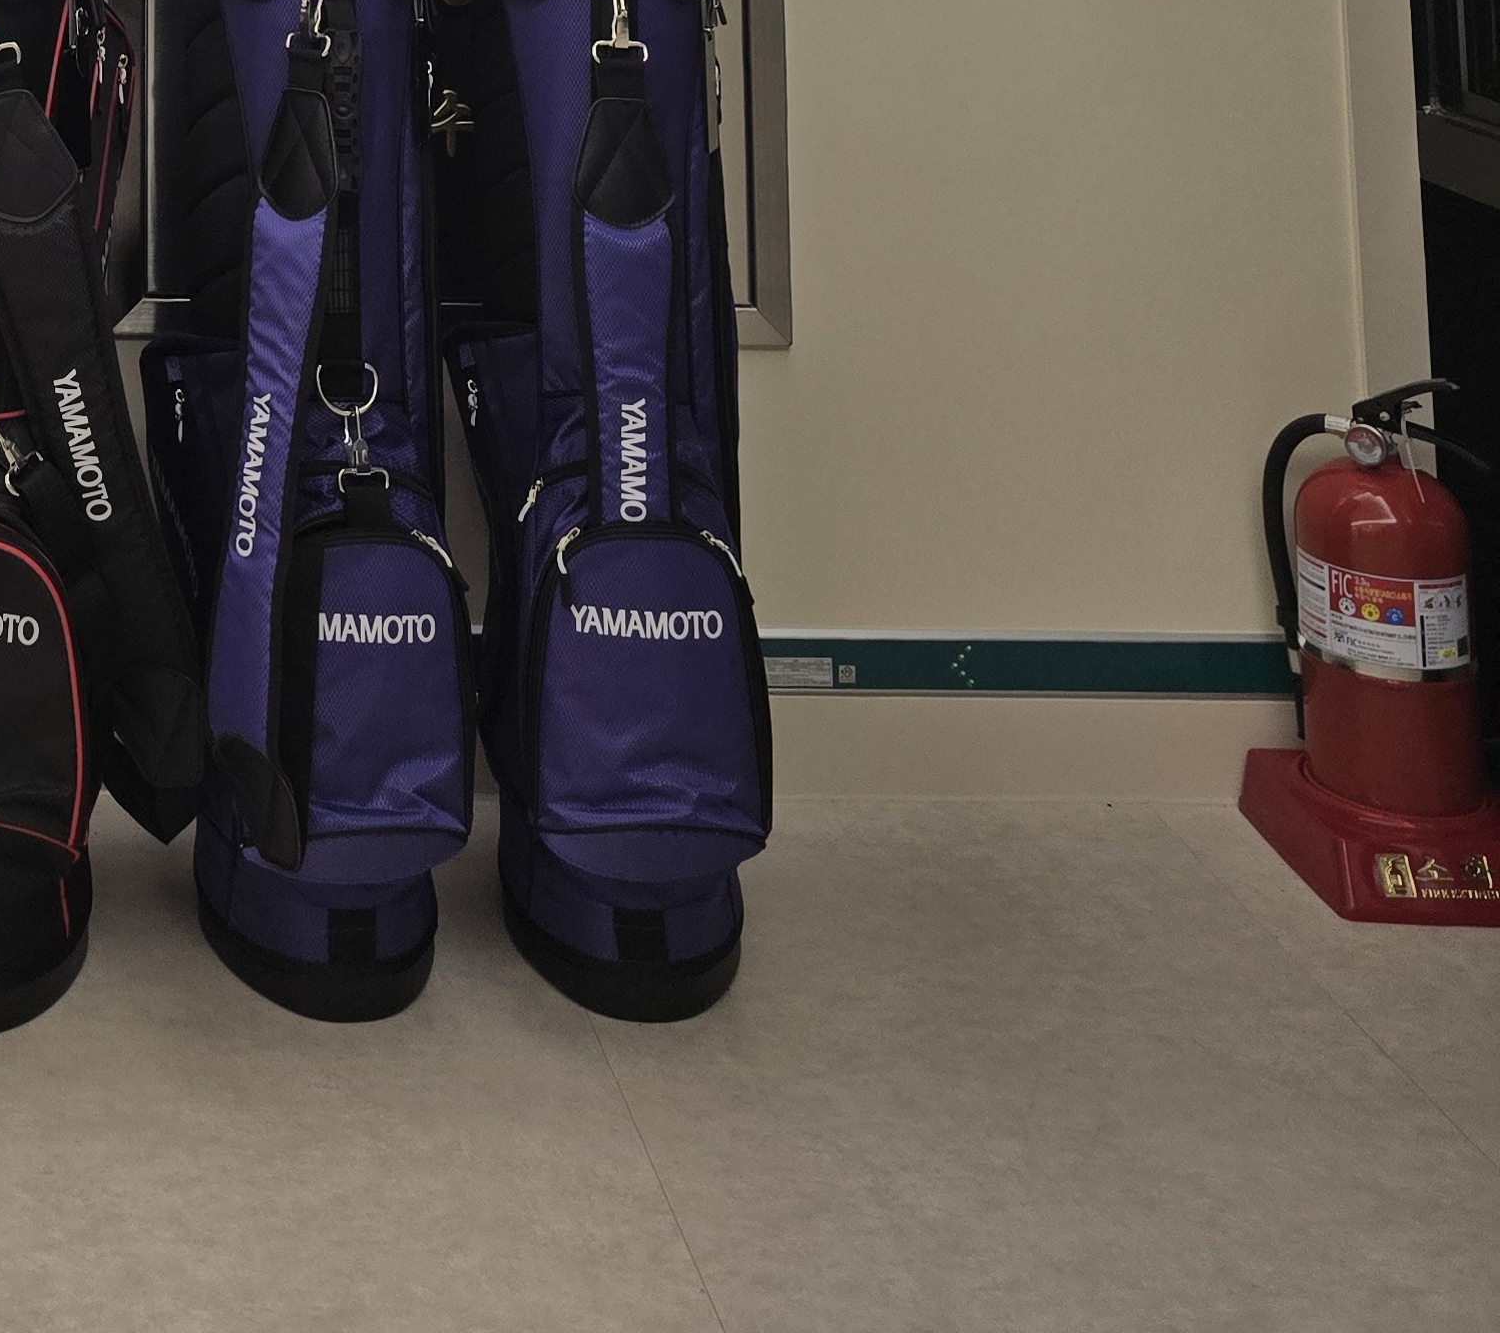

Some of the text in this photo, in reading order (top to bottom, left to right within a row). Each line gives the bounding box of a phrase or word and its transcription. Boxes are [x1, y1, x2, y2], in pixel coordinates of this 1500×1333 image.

[53, 368, 113, 522] YAMAMOTO
[234, 393, 271, 557] YAMAMOTO
[619, 398, 647, 523] YAMAMO
[570, 604, 723, 639] YAMAMOTO
[1331, 569, 1353, 598] FIC
[319, 612, 436, 644] MAMOTO
